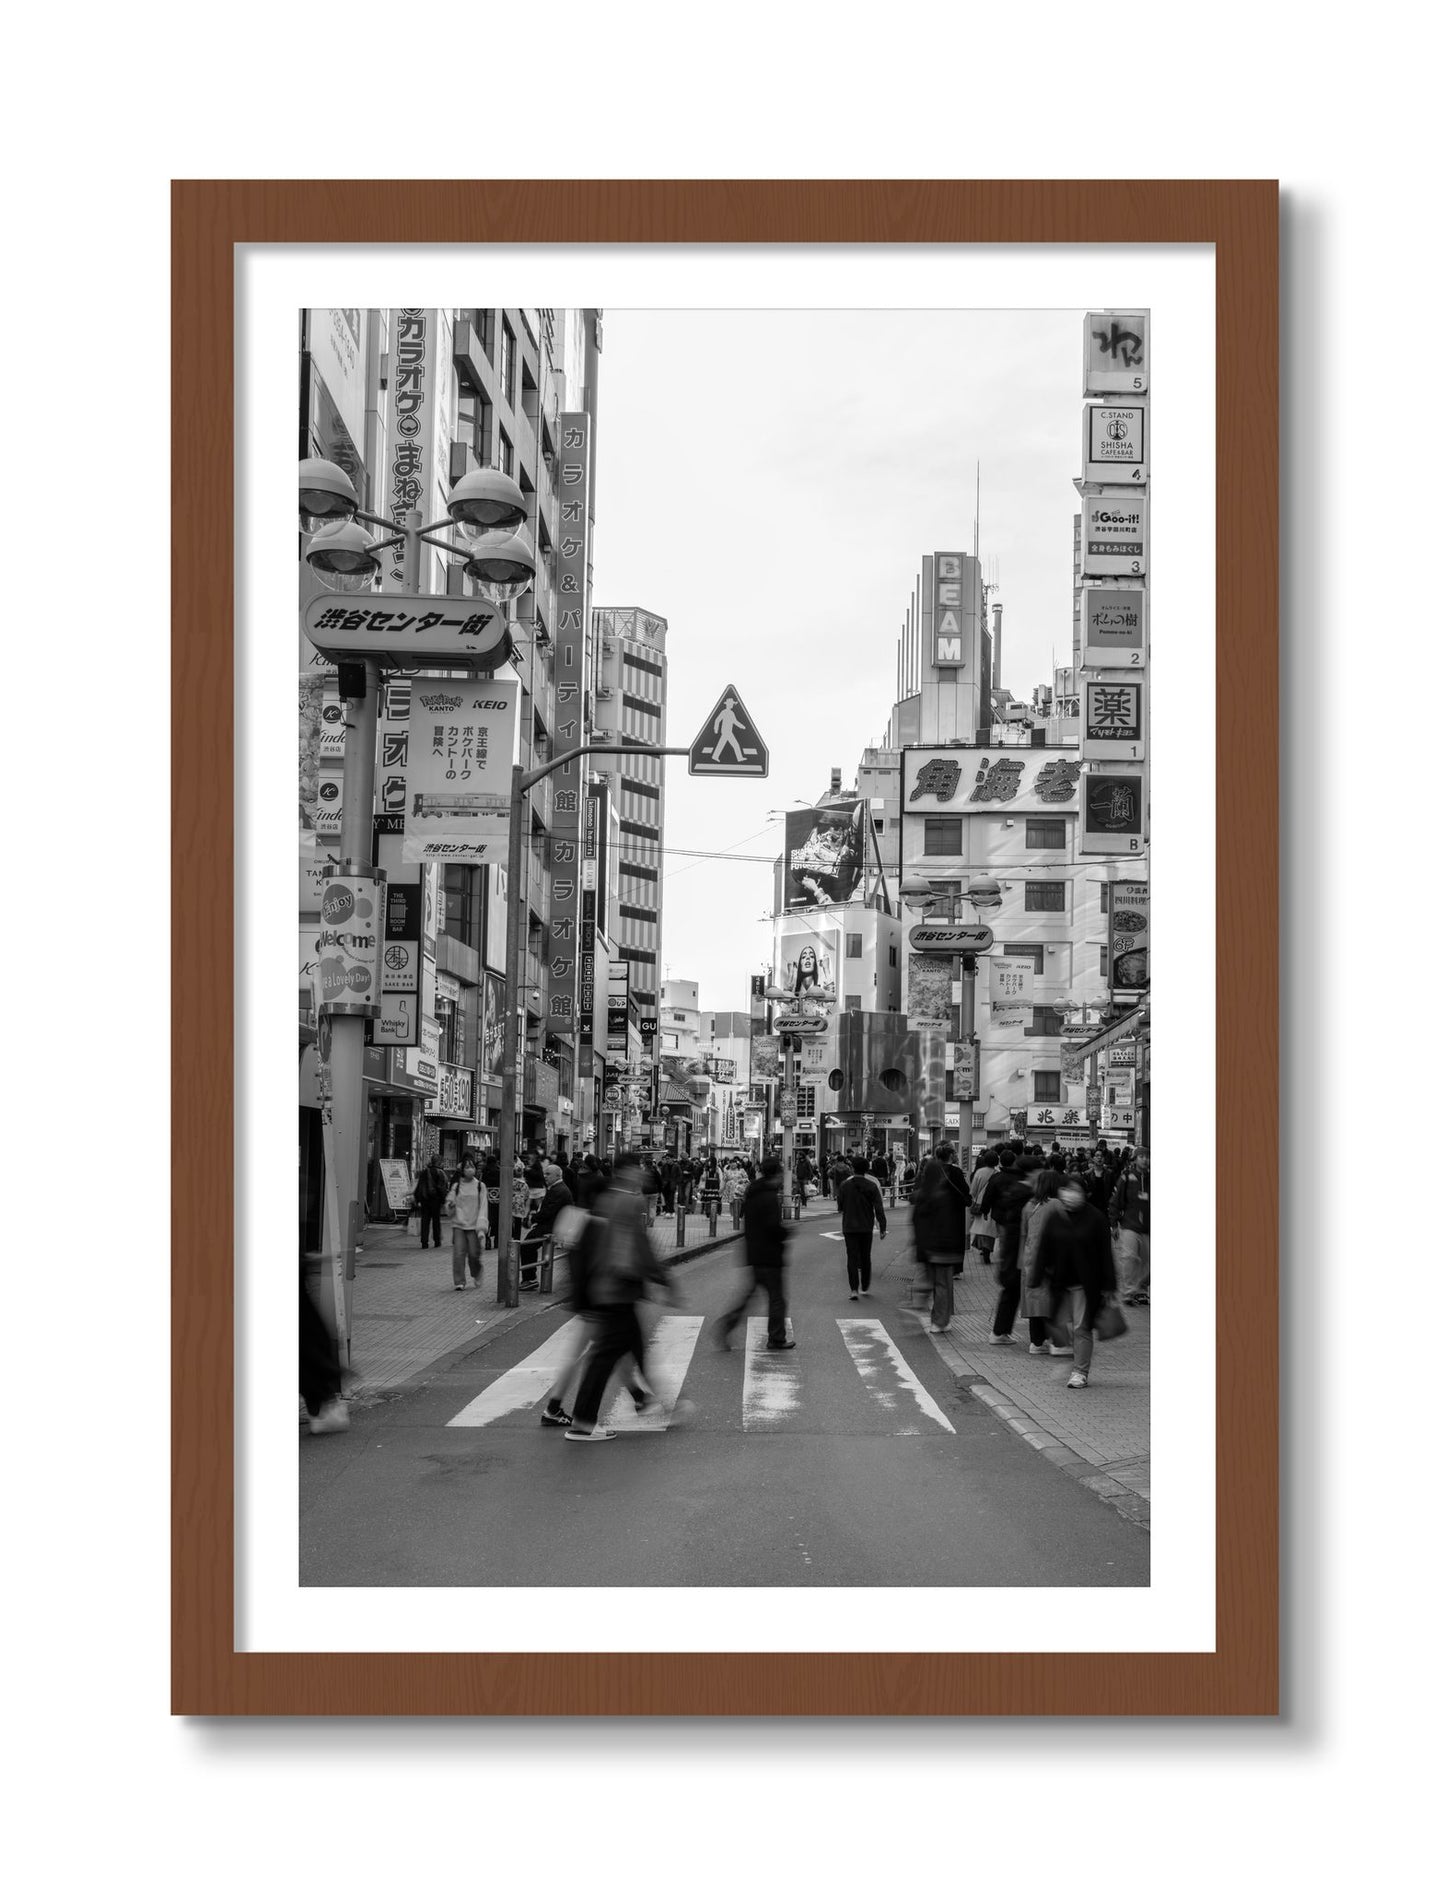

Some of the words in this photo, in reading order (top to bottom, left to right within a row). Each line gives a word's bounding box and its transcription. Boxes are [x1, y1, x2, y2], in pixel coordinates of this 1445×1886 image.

[396, 317, 426, 415] カラオケ
[1133, 377, 1143, 389] 5
[1100, 441, 1133, 449] SHISHA
[1100, 512, 1139, 524] Goo-it!
[1132, 561, 1140, 573] 3
[937, 557, 962, 661] BEAM
[313, 608, 494, 635] 渋谷センター街
[1131, 653, 1139, 665] 2
[472, 700, 507, 710] KEIO
[1094, 689, 1131, 725] 薬
[433, 726, 445, 757] 冒険へ
[446, 727, 458, 780] カントーの
[1131, 747, 1137, 757] 1
[423, 843, 488, 854] 渋谷センター街
[1130, 839, 1138, 850] B
[323, 894, 351, 918] Enjoy
[550, 842, 575, 1018] カラオケ館
[915, 931, 988, 940] 渋谷センター街
[320, 930, 376, 949] Welcome
[1113, 937, 1135, 953] 6F
[381, 1020, 405, 1028] Whisky
[641, 1023, 657, 1031] GU
